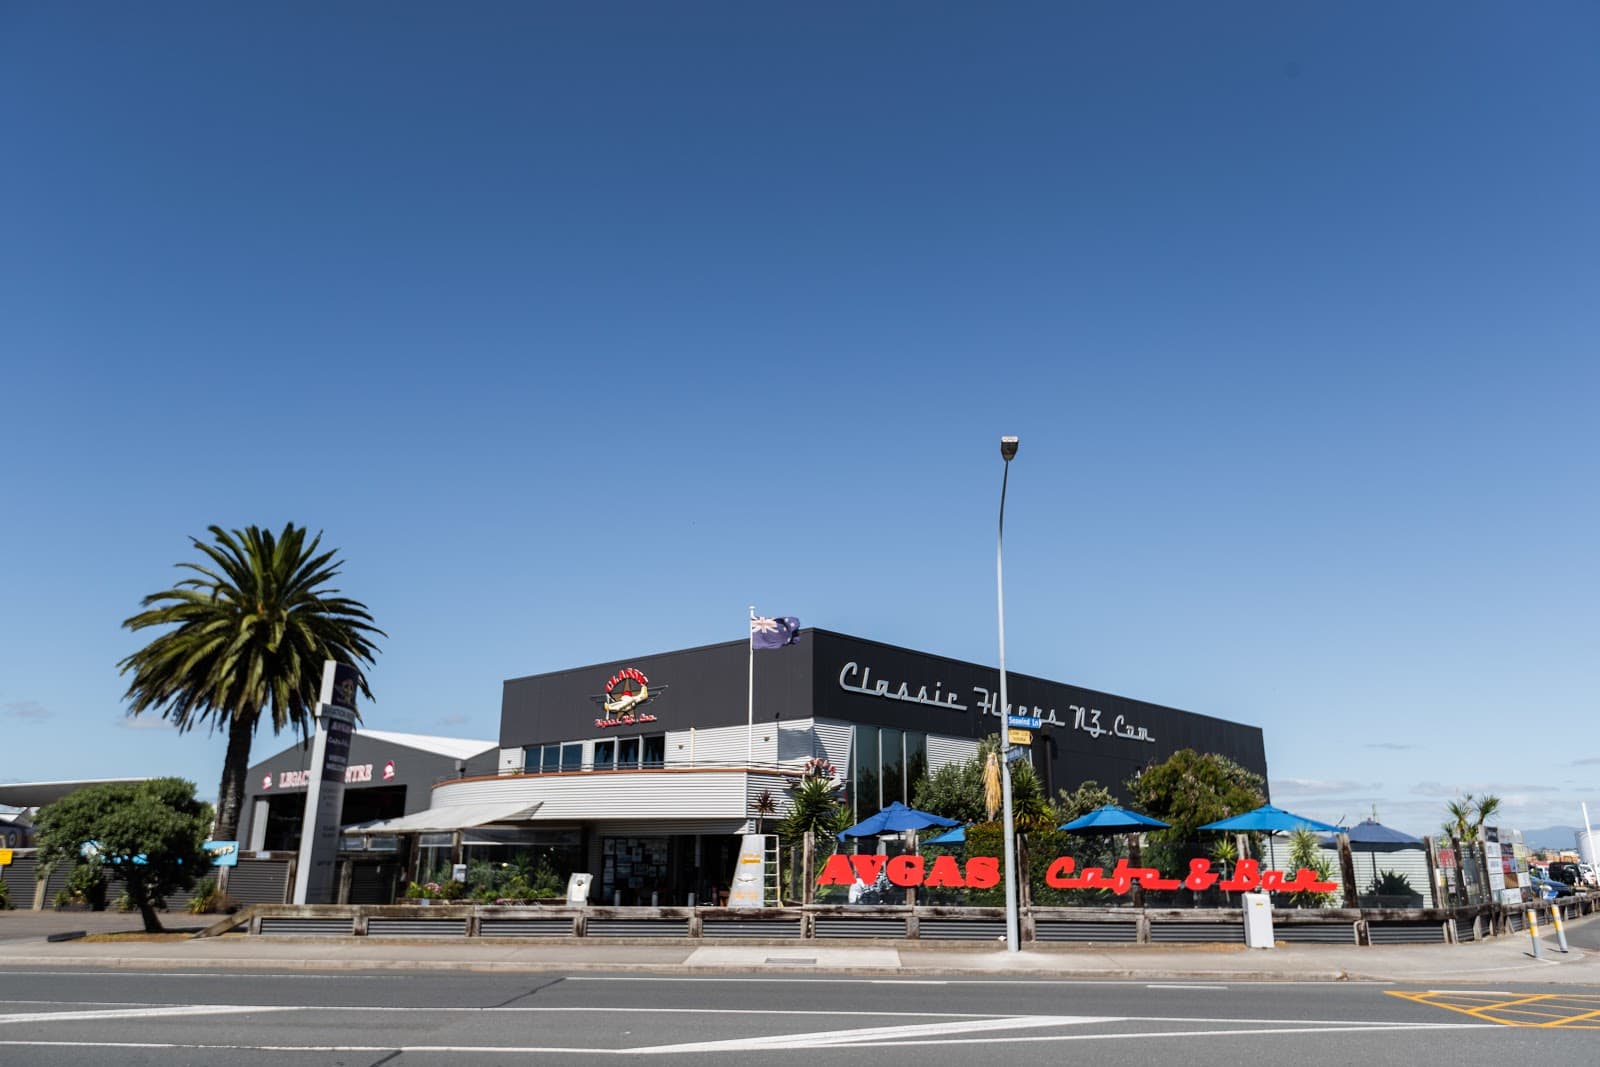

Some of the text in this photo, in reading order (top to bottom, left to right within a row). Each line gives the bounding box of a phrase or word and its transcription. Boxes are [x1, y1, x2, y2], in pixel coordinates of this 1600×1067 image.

[839, 661, 968, 711] Classic
[1032, 718, 1040, 727] Ln
[344, 764, 373, 784] NTRE
[816, 854, 1000, 889] AVGAS
[1045, 856, 1338, 895] Cafe & Bar
